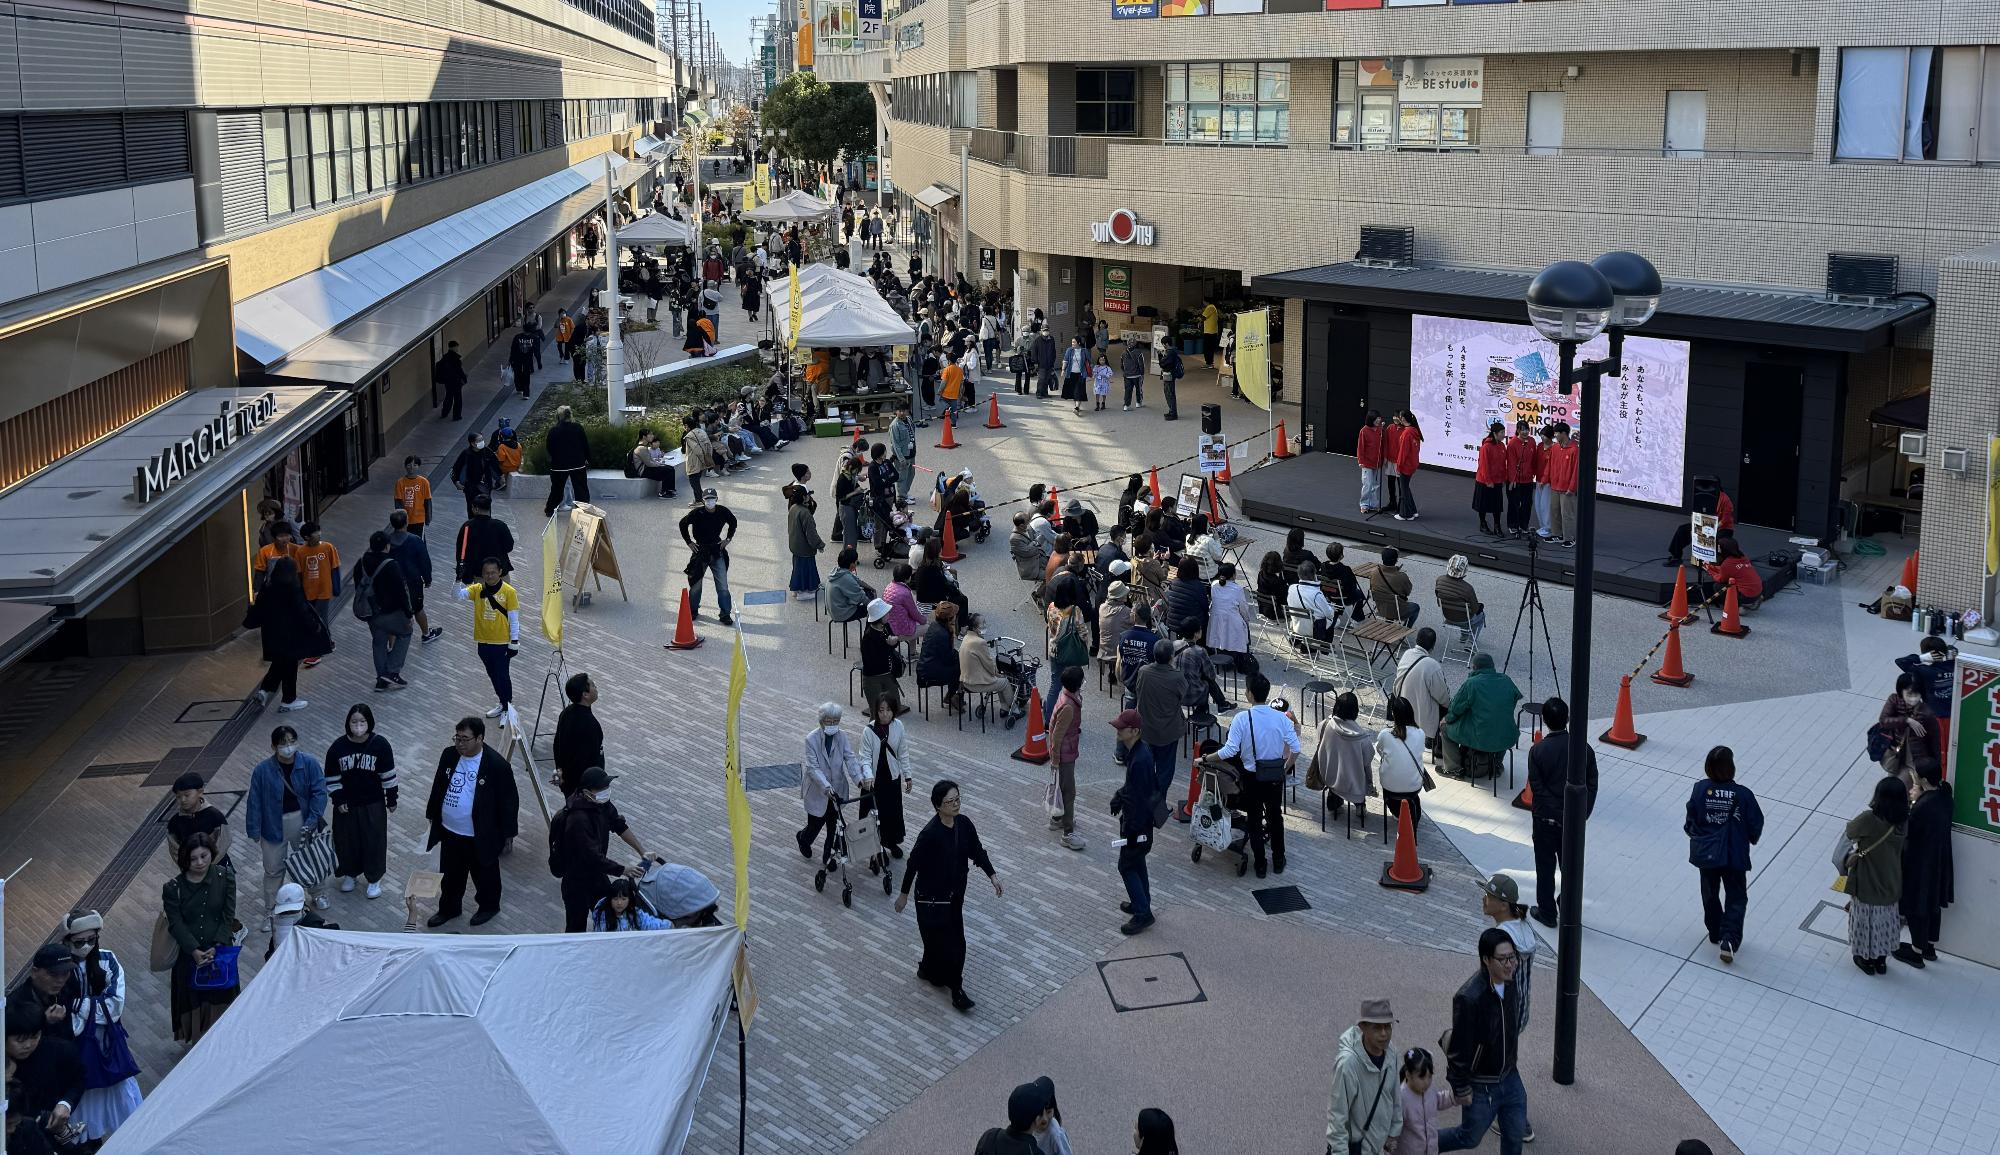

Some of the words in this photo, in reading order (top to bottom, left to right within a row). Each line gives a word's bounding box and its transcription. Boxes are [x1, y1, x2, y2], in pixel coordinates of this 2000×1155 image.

[864, 0, 876, 14] 院
[862, 20, 879, 34] 2F
[1422, 78, 1436, 90] BE
[1438, 77, 1479, 90] studio
[1619, 364, 1630, 419] みんなが主役
[1516, 401, 1567, 417] OSAMPO
[1634, 365, 1645, 449] あなたも、わたしも、
[144, 400, 238, 503] MARCHÉ
[239, 391, 279, 437] IKEDA
[1964, 669, 1990, 687] 2F
[355, 752, 378, 772] YORK
